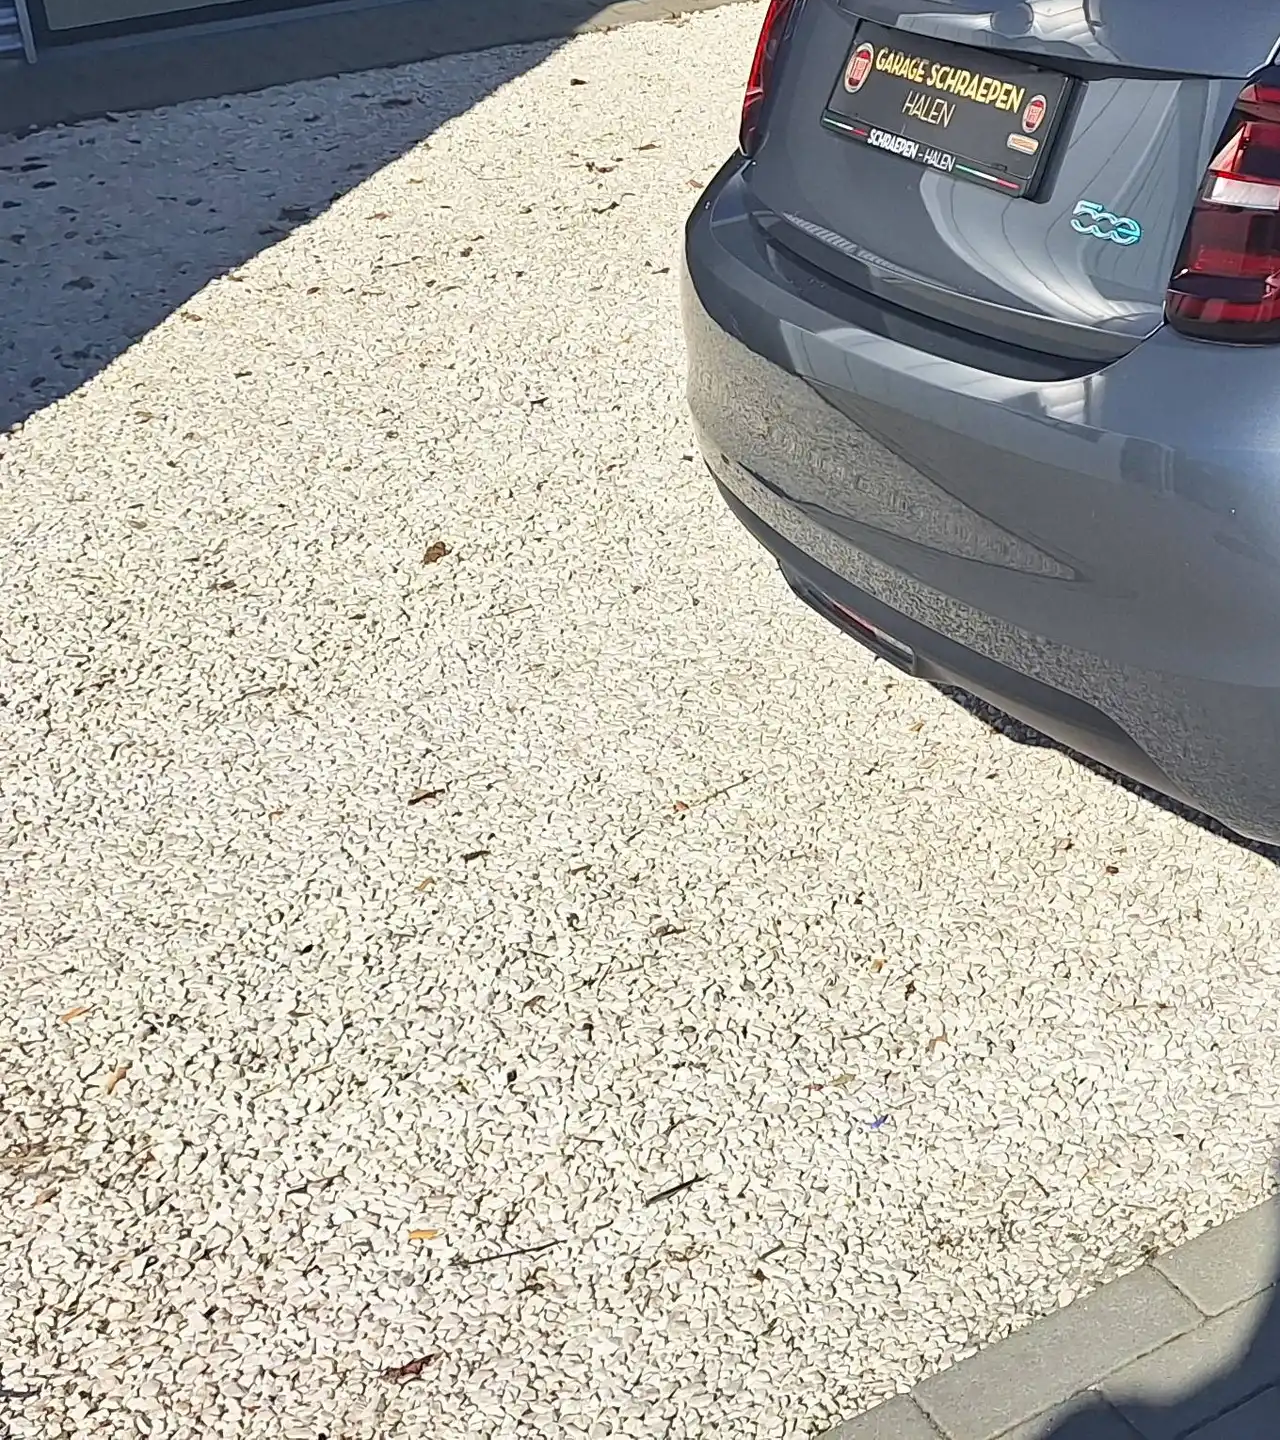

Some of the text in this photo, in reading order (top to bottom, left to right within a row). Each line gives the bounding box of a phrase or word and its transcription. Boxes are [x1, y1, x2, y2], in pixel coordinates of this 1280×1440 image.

[876, 47, 929, 83] GARAGE
[926, 63, 1025, 113] SCHRAEPEN
[902, 90, 956, 128] HALEN
[867, 128, 919, 160] SCHRAEPEN
[923, 147, 956, 172] HALEN
